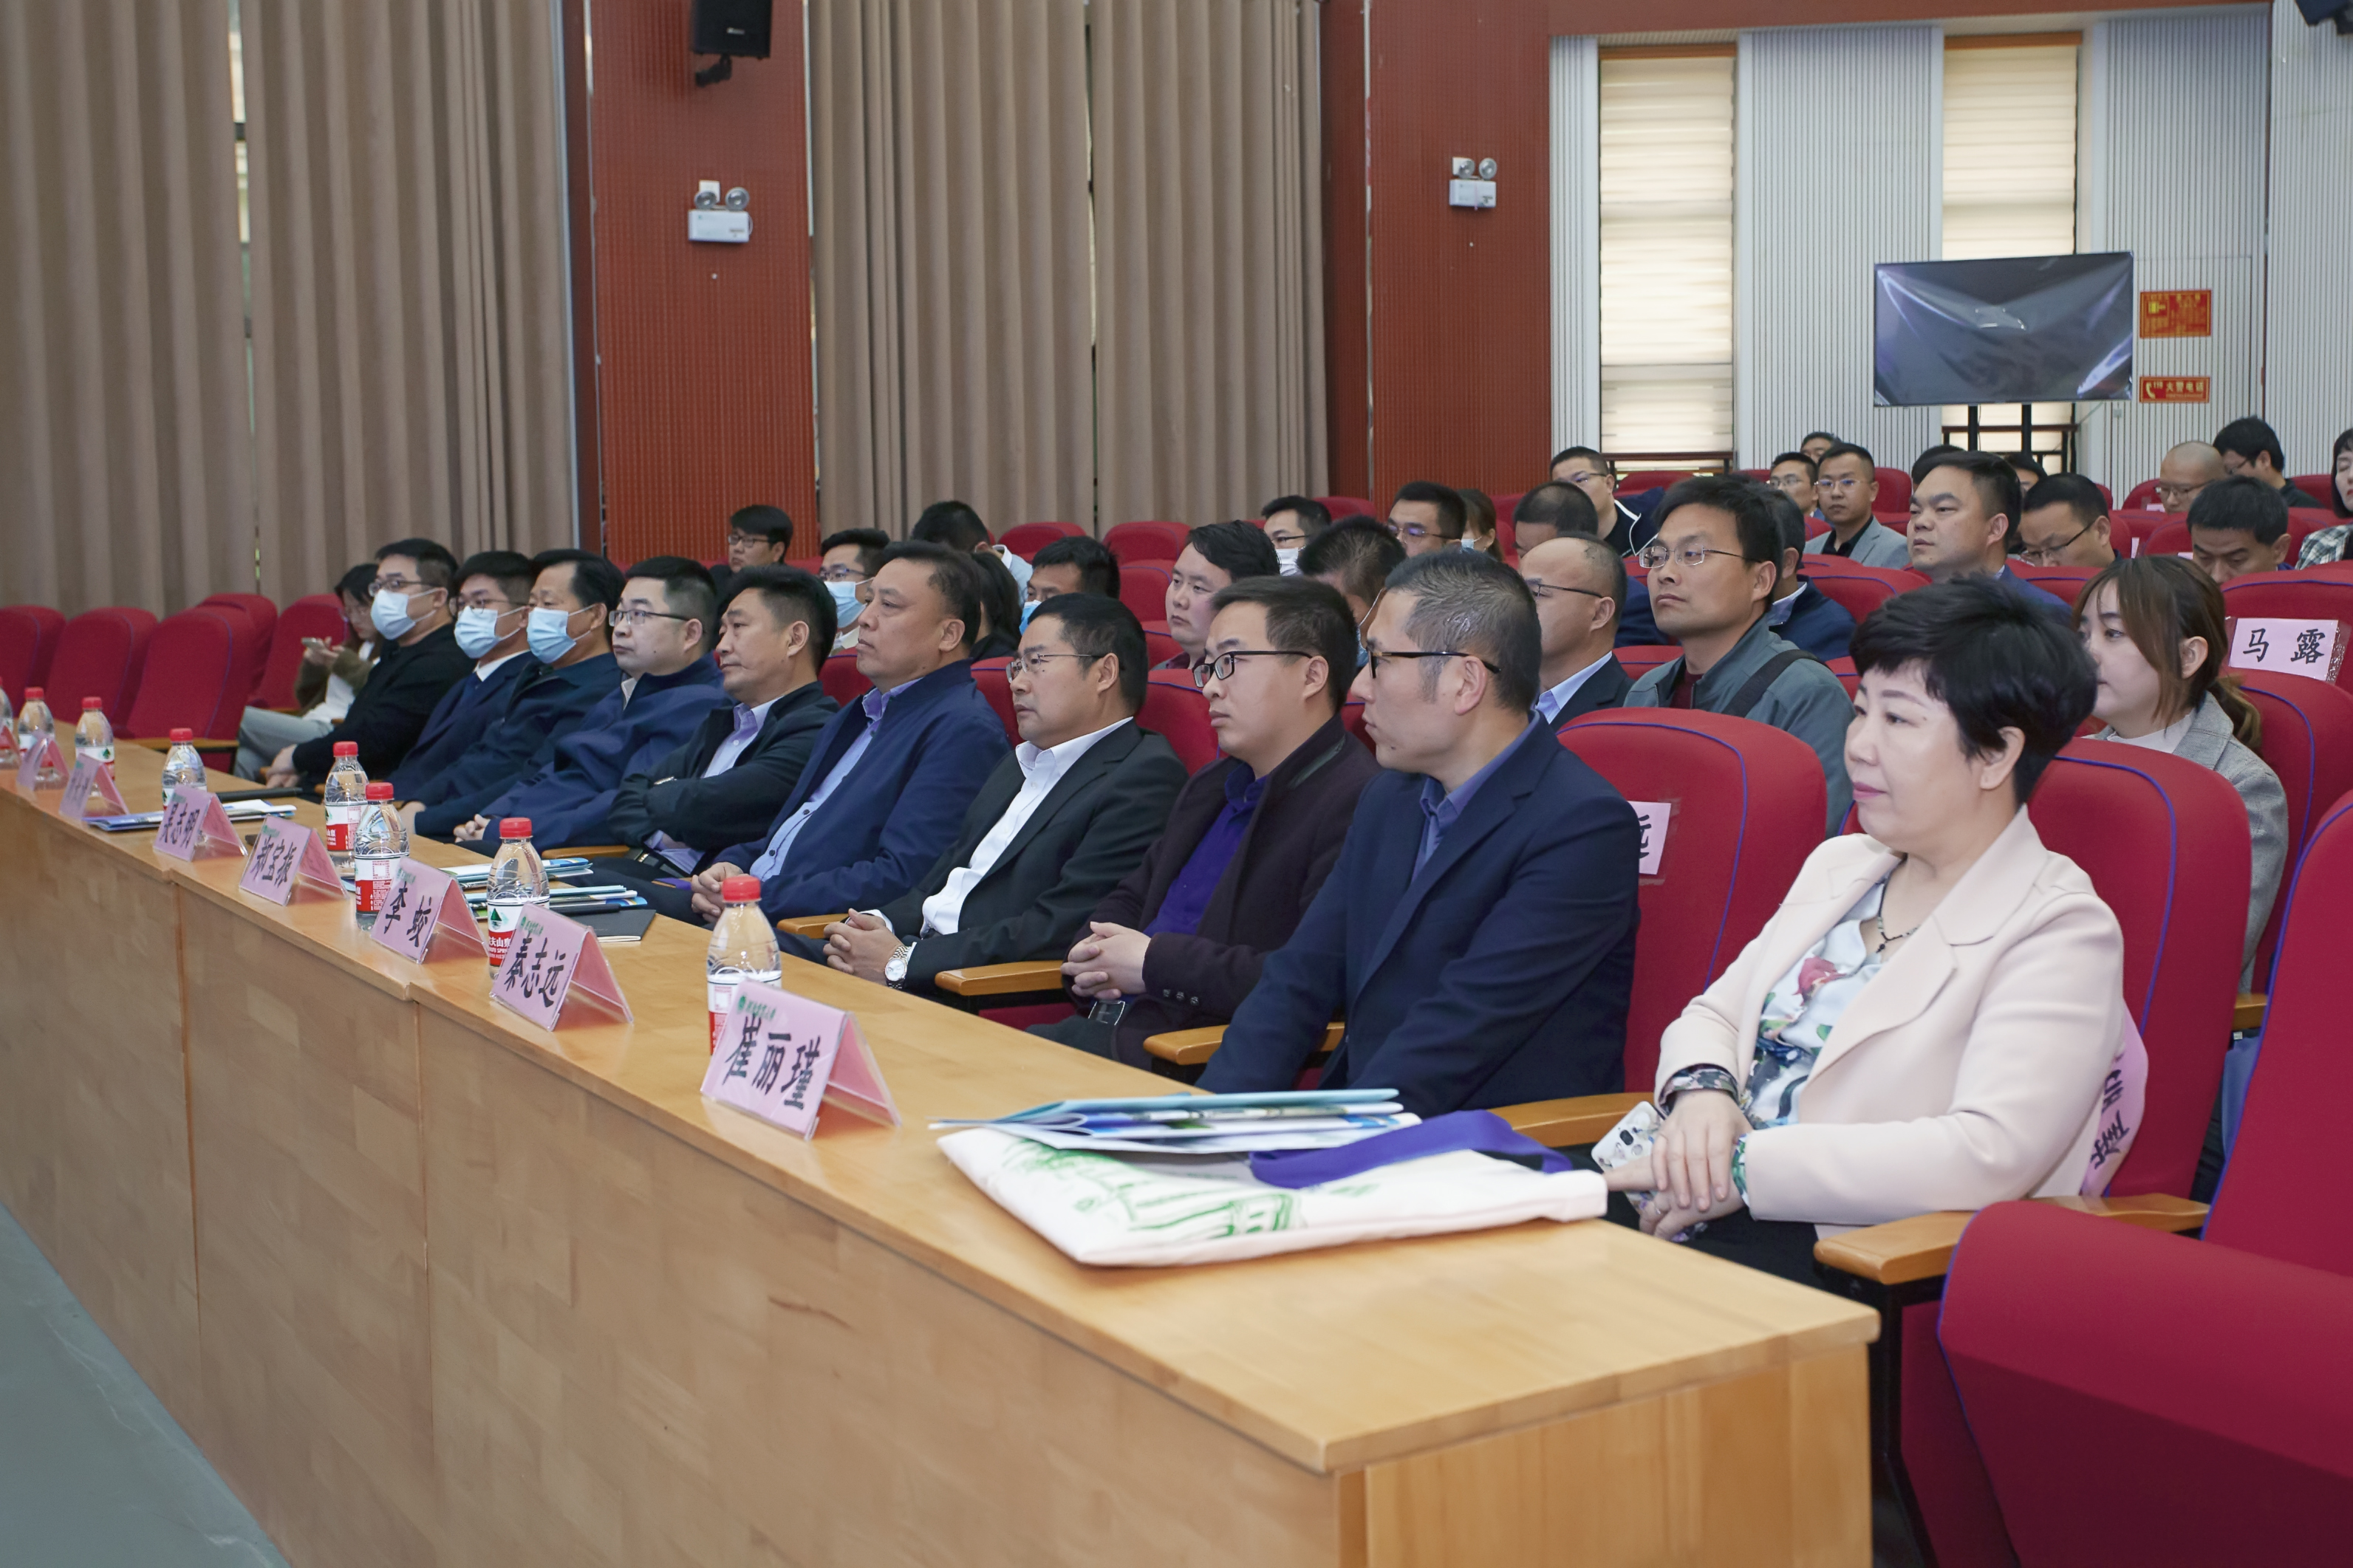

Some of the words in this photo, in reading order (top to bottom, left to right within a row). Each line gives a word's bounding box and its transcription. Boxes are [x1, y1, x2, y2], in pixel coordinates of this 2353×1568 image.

[2242, 628, 2326, 665] 马露
[250, 835, 297, 889] 郑宝振
[383, 881, 432, 948] 李蛟
[504, 931, 567, 1008] 秦志远
[721, 1013, 822, 1110] 崔丽瑾
